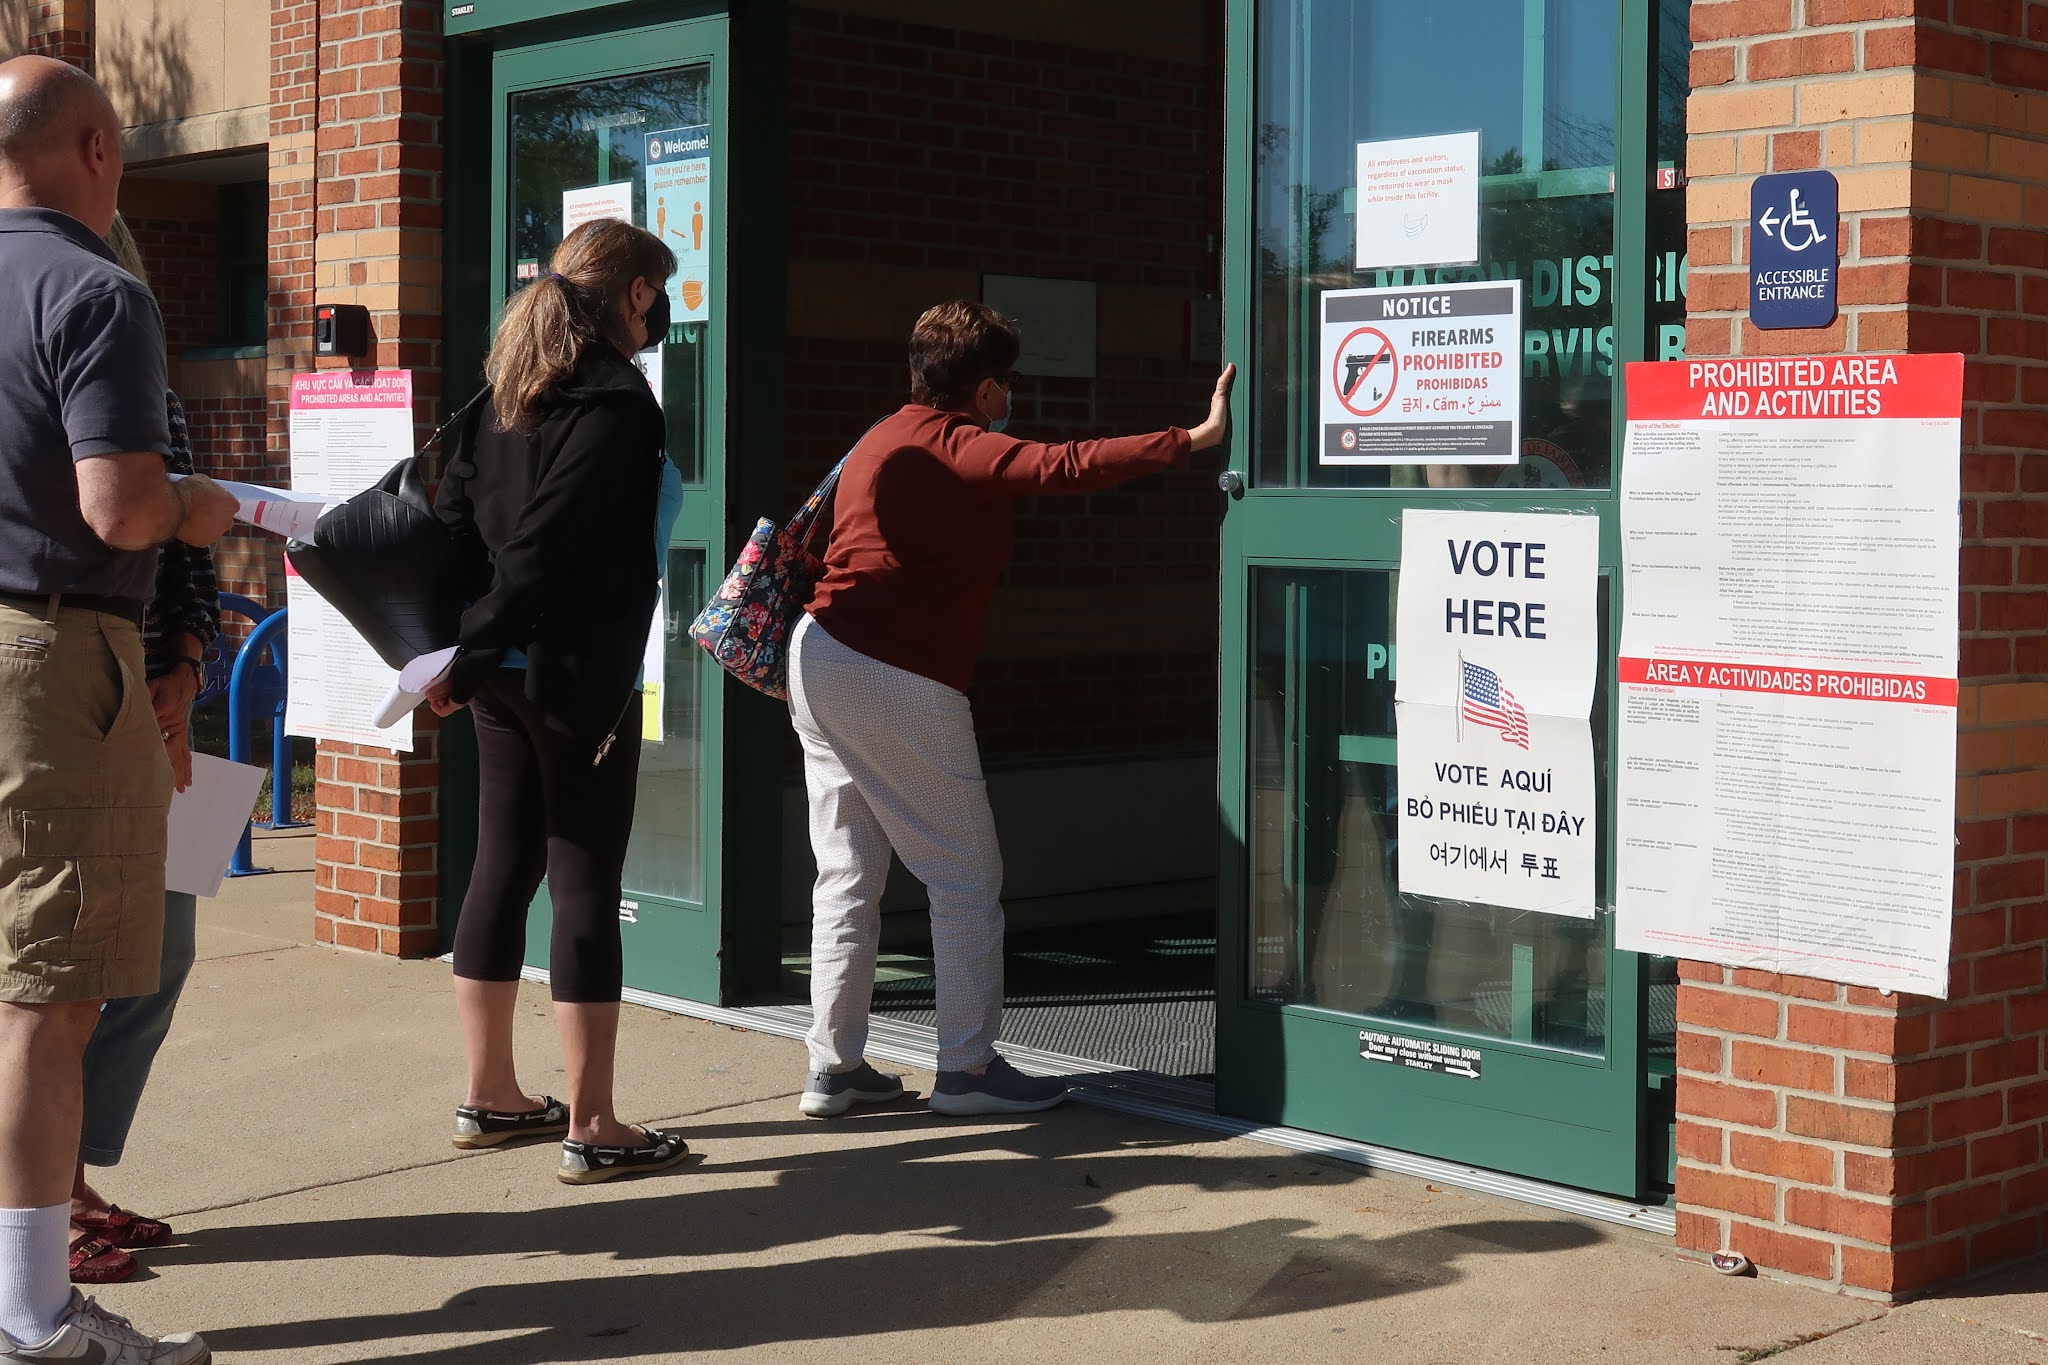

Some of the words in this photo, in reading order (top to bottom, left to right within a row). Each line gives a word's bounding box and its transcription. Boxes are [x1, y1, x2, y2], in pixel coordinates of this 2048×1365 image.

[664, 135, 709, 155] Welcome!
[654, 166, 671, 177] While
[671, 163, 691, 176] you're
[690, 161, 708, 172] here,
[1368, 160, 1376, 168] All
[1377, 158, 1410, 168] employees
[1411, 156, 1423, 164] and
[1424, 154, 1449, 163] visitors,
[1368, 171, 1399, 181] regardless
[1399, 168, 1406, 176] of
[1407, 166, 1443, 176] vaccination
[1444, 164, 1466, 173] status,
[653, 179, 673, 192] please
[673, 174, 708, 187] remember:
[1368, 184, 1378, 192] are
[1378, 180, 1405, 191] required
[1406, 180, 1413, 188] to
[1414, 180, 1430, 188] wear
[1436, 177, 1454, 186] mask
[1368, 194, 1384, 203] while
[1385, 192, 1404, 202] inside
[1405, 191, 1416, 200] this
[1417, 190, 1440, 200] facility.
[1756, 268, 1829, 286] ACCESSIBLE
[1759, 284, 1825, 301] ENTRANCE
[1382, 296, 1451, 318] NOTICE
[1411, 327, 1495, 347] FIREARMS
[1403, 351, 1503, 371] PROHIBITED
[1689, 360, 1826, 389] PROHIBITED
[1831, 358, 1898, 386] AREA
[295, 380, 311, 391] KHU
[1416, 377, 1489, 391] PROHIBIDAS
[301, 393, 338, 404] PROHIBITED
[338, 393, 359, 404] AREAS
[360, 393, 373, 403] AND
[373, 392, 406, 403] ACTIVITIES
[1402, 397, 1423, 413] 금지
[1432, 396, 1459, 411] Cấm
[1467, 395, 1502, 415] ممنوع
[1701, 391, 1750, 417] AND
[1754, 388, 1882, 416] ACTIVITIES
[1448, 538, 1547, 581] VOTE
[1445, 597, 1547, 641] HERE
[1646, 659, 1688, 684] ÁREA
[1692, 665, 1704, 685] Y
[1708, 667, 1813, 694] ACTIVIDADES
[1817, 676, 1926, 700] PROHIBIDAS
[1434, 761, 1489, 788] VOTE
[1500, 767, 1553, 794] AQUÍ
[1406, 794, 1434, 820] BỎ
[1439, 799, 1498, 828] PHIẾU
[1504, 808, 1537, 837] TẠI
[1541, 809, 1586, 838] ĐÂY
[1429, 841, 1509, 876] 여기에서
[1520, 853, 1561, 880] 투표
[1360, 1030, 1391, 1046] CAUTION:
[1391, 1036, 1432, 1053] AUTOMATIC
[1432, 1043, 1461, 1057] SLIDING
[1461, 1048, 1482, 1061] DOOR
[1368, 1041, 1385, 1053] Door
[1385, 1046, 1399, 1057] may
[1399, 1047, 1417, 1059] close
[1418, 1051, 1443, 1064] without
[1444, 1056, 1472, 1070] warning
